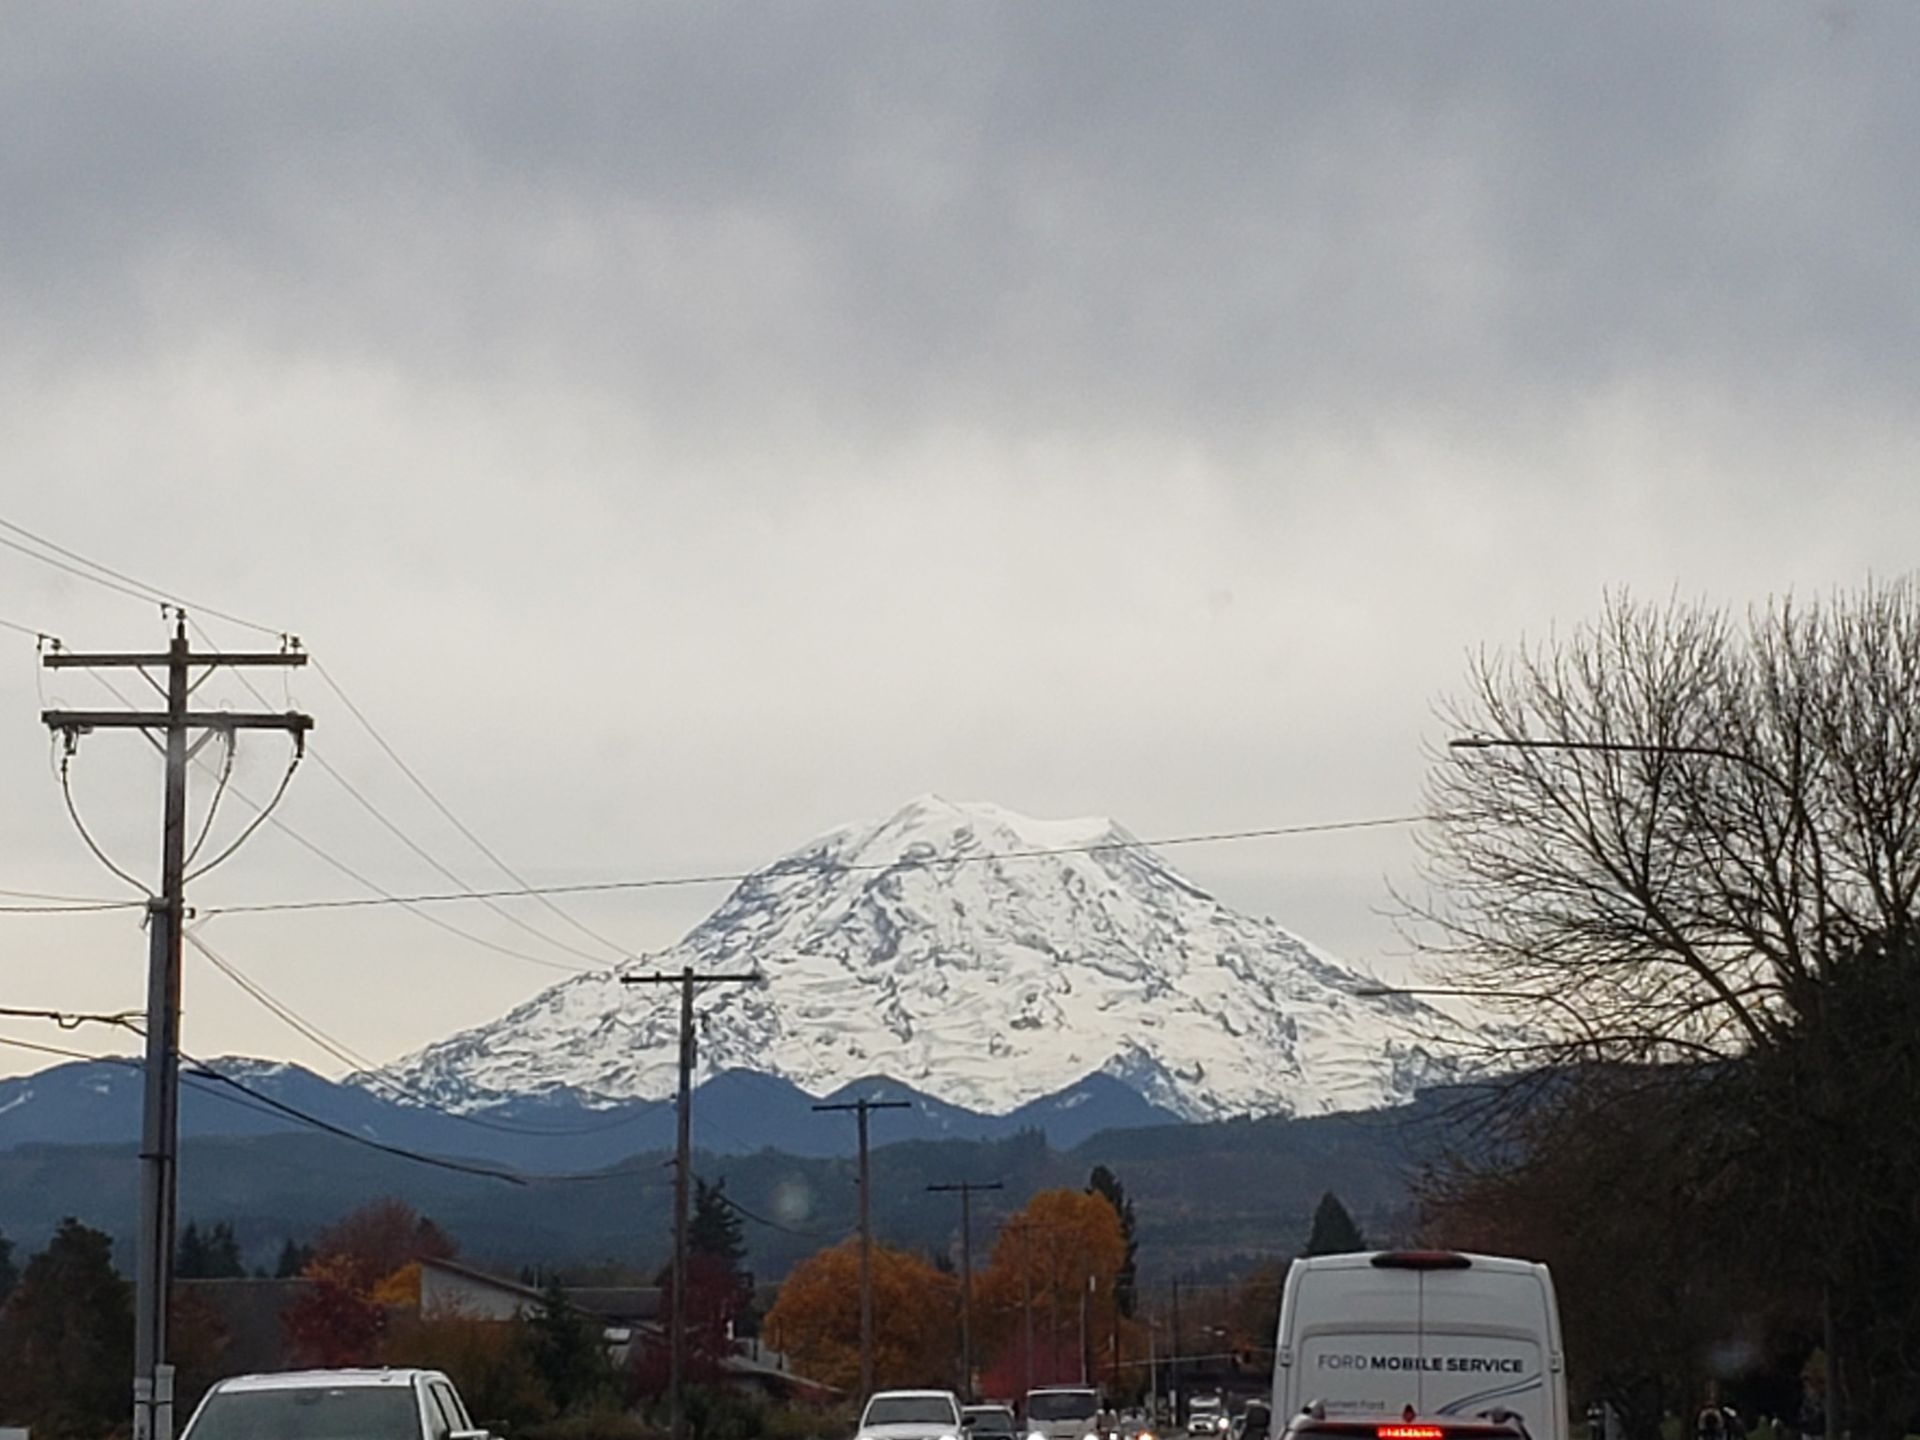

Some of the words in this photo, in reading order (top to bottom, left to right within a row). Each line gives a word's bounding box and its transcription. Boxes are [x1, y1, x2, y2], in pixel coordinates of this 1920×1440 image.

[1318, 1355, 1367, 1369] FORD
[1371, 1356, 1442, 1371] MOBILE
[1447, 1358, 1523, 1373] SERVICE
